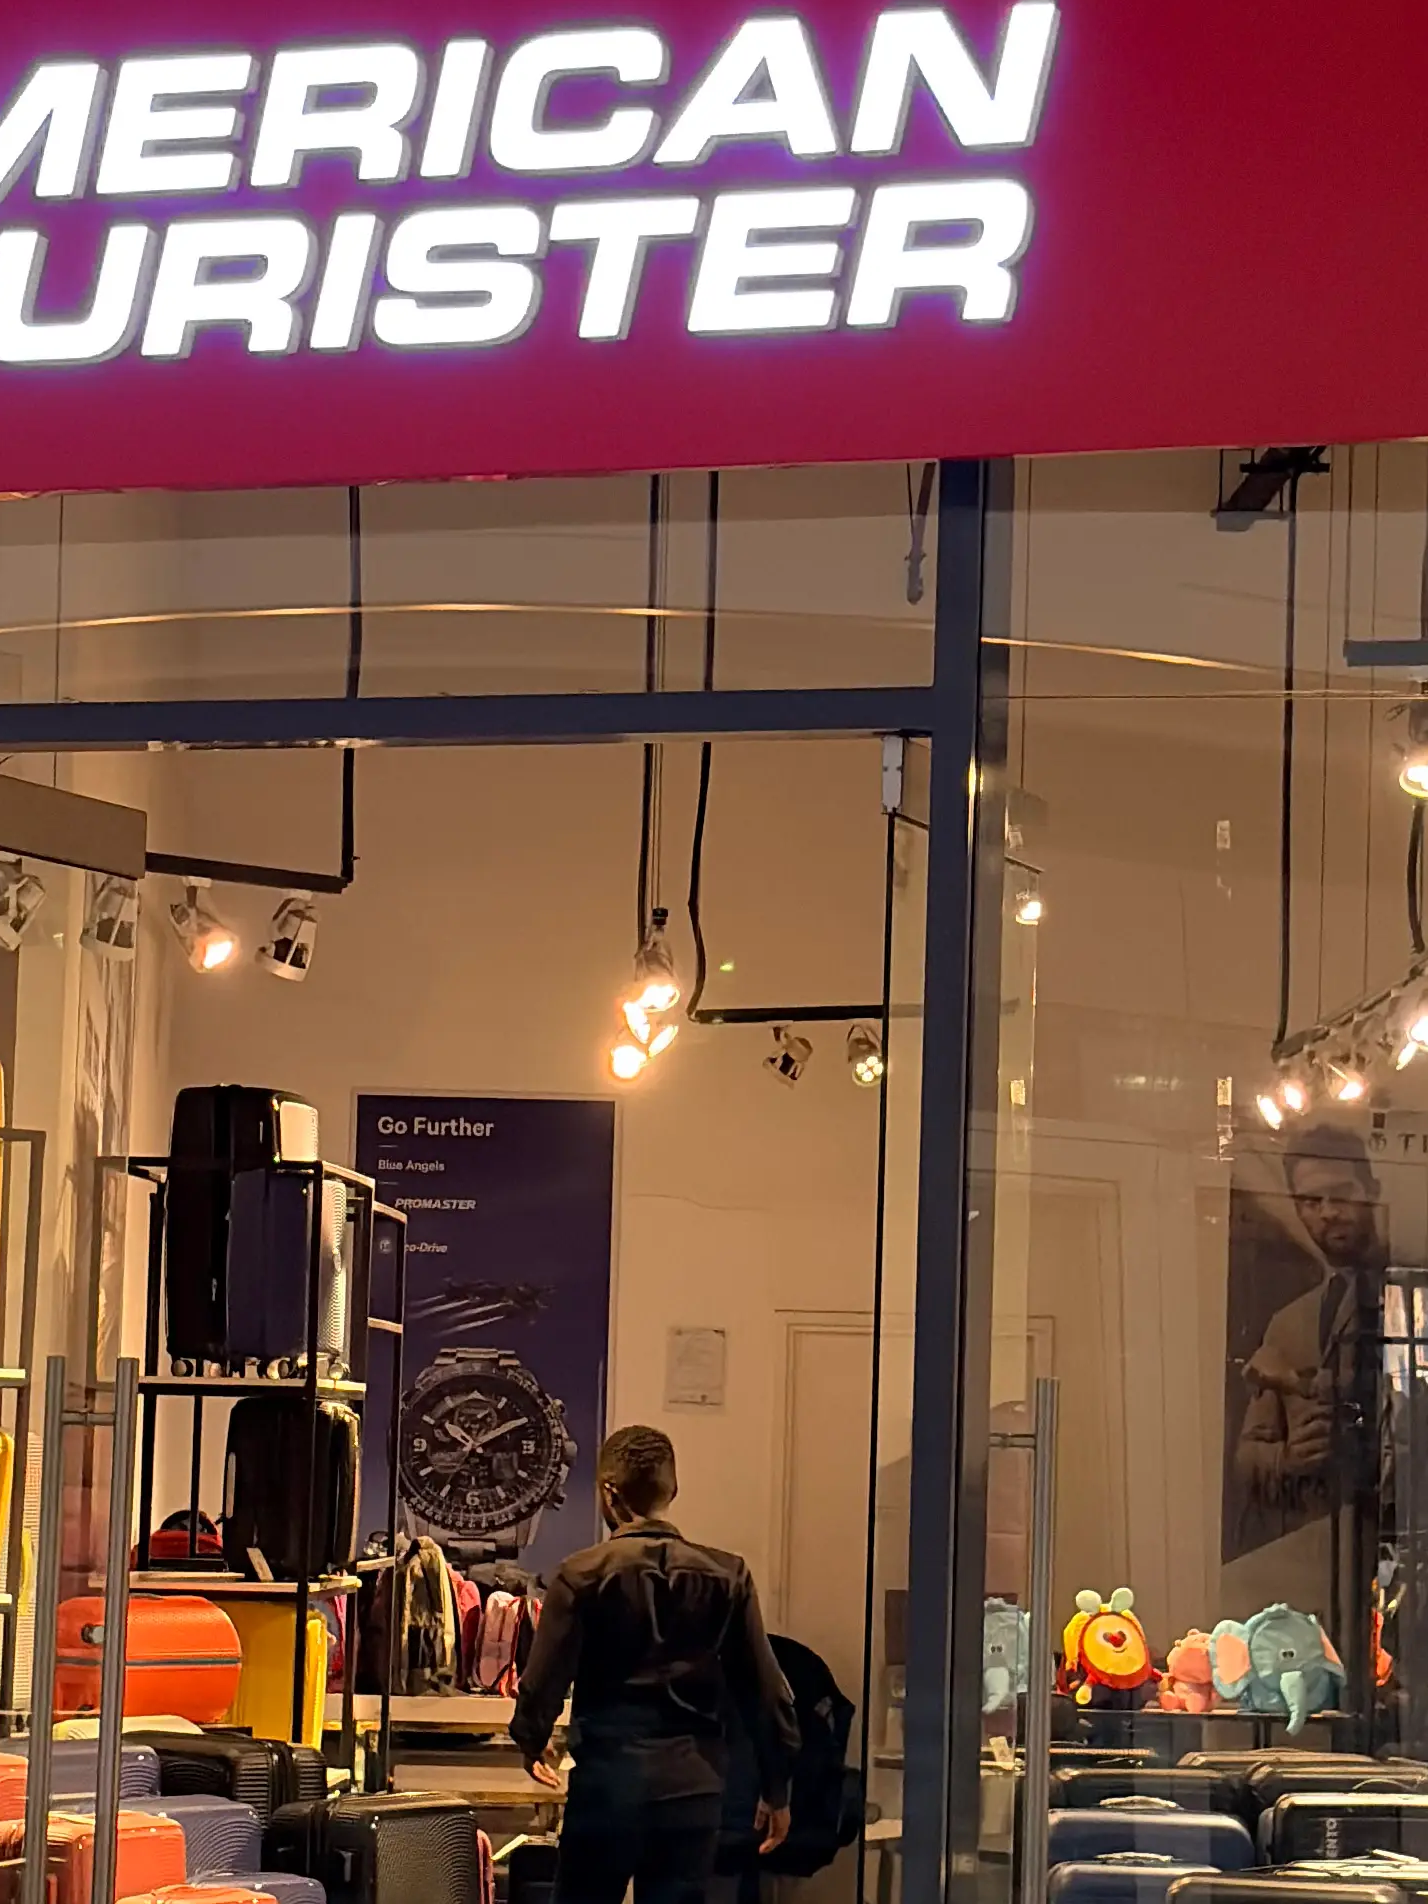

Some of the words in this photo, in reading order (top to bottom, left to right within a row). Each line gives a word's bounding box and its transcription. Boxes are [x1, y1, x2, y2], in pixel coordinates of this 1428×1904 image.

[378, 1116, 408, 1135] Go
[413, 1116, 495, 1137] Further
[405, 1159, 445, 1173] Angels
[394, 1198, 476, 1211] PROMASTER
[404, 1242, 449, 1254] co-Drive
